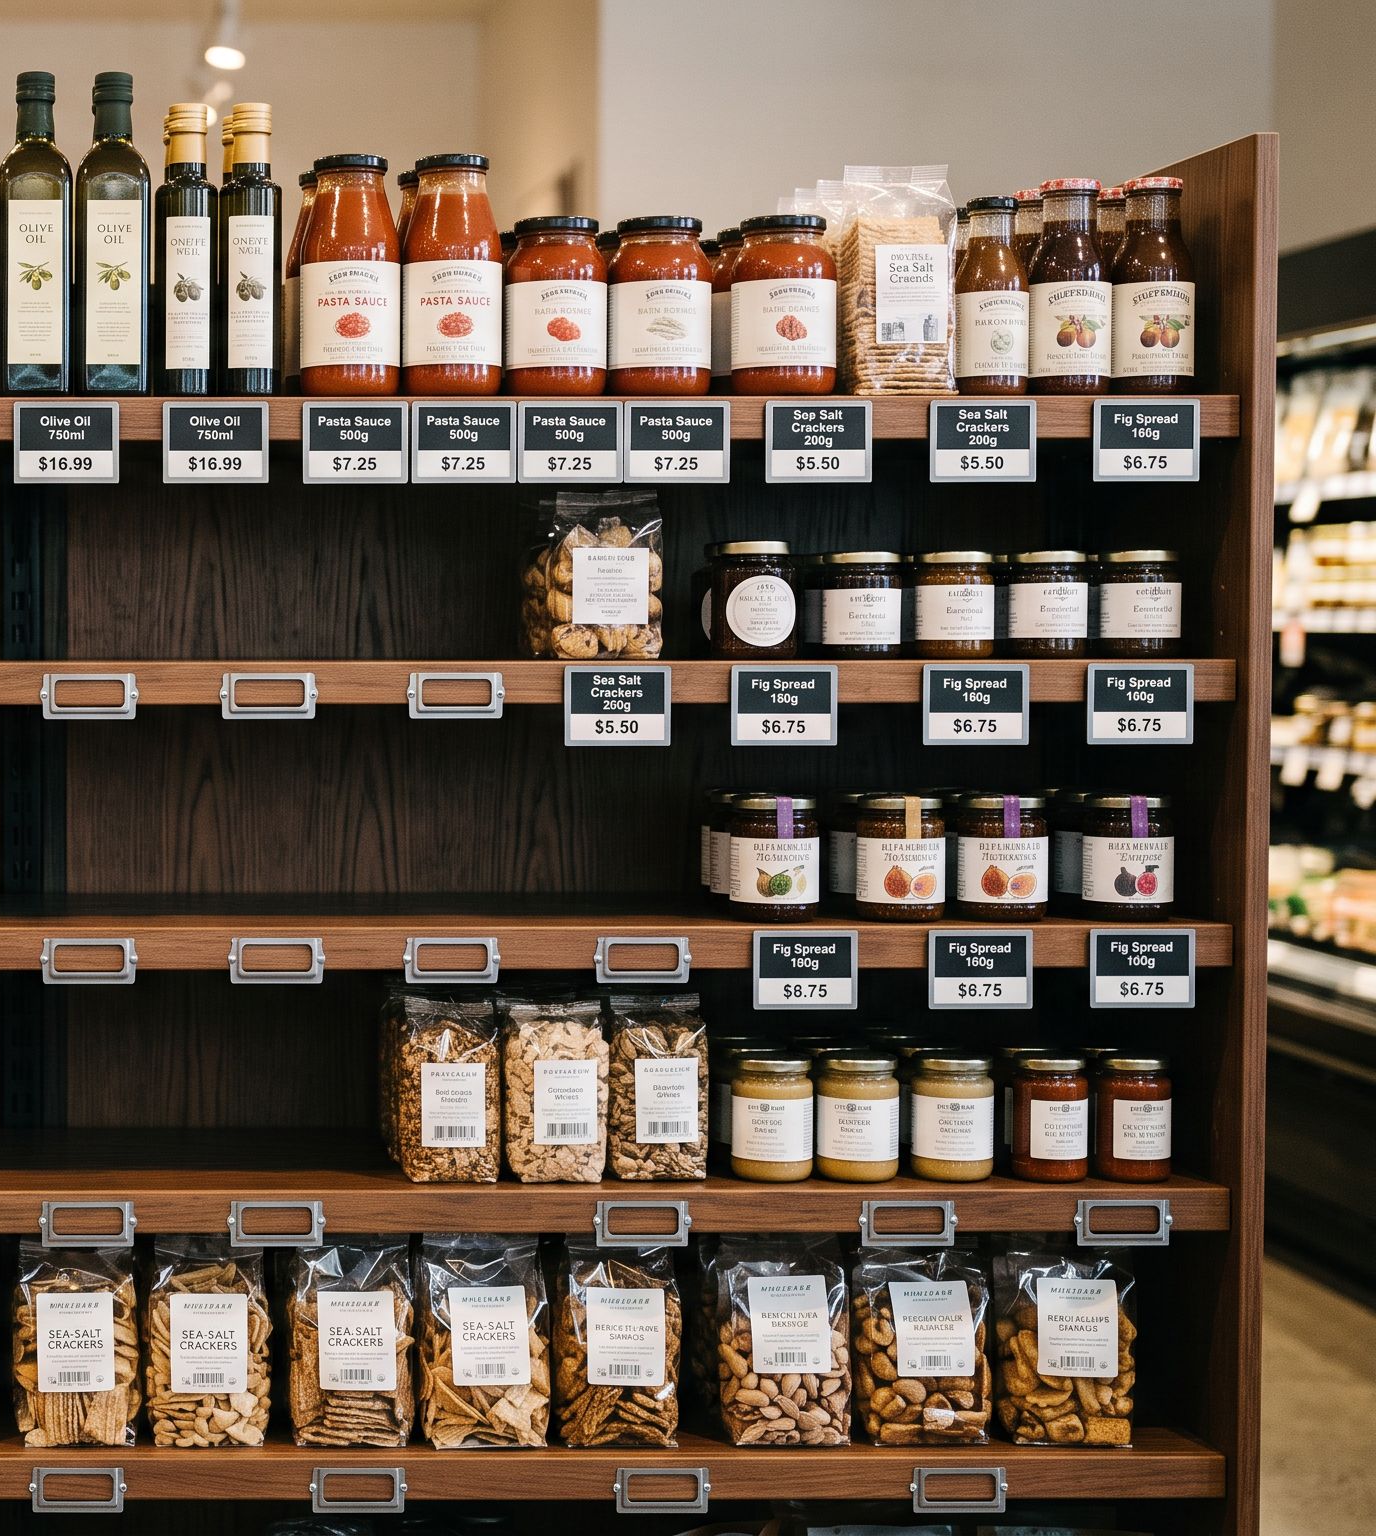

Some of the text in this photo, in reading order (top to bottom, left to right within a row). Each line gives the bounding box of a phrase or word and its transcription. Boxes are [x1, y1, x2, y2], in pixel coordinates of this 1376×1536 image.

[19, 224, 53, 232] OLIVE
[97, 224, 131, 232] OLIVE
[26, 235, 45, 243] OIL
[104, 235, 123, 244] OIL
[890, 263, 933, 272] Sea Salt
[318, 297, 389, 307] PASTA SAUCE
[421, 297, 492, 306] PASTA SAUCE
[959, 409, 1007, 419] Sea Salt
[40, 416, 90, 426] Olive Oil
[190, 416, 240, 426] Olive Oil
[318, 416, 391, 426] Pasta Sauce
[427, 416, 500, 426] Pasta Sauce
[533, 416, 606, 426] Pasta Sauce
[1114, 413, 1178, 426] Fig Spread
[956, 422, 1009, 432] Crackers
[49, 430, 84, 440] 750ml
[197, 430, 233, 440] 750ml
[340, 430, 368, 443] 500g
[450, 429, 478, 442] 500g
[555, 430, 584, 442] 500g
[969, 435, 997, 447] 200g
[38, 456, 93, 472] $16.99
[188, 456, 242, 472] $16.99
[332, 456, 377, 472] $7.25
[441, 456, 485, 472] $7.25
[547, 456, 592, 472] $7.25
[960, 455, 1004, 471] $5.50
[1123, 455, 1168, 471] $6.75
[752, 679, 815, 691] Fig Spread
[944, 678, 1007, 691] Fig Spread
[761, 719, 806, 735] $6.75
[953, 718, 997, 735] $6.75
[773, 944, 835, 957] Fig Spread
[949, 942, 1011, 956] Fig Spread
[783, 983, 828, 1000] $8.75
[958, 982, 1002, 999] $6.75
[463, 1321, 514, 1330] SEA-SALT
[49, 1329, 101, 1339] SEA-SALT
[182, 1330, 235, 1339] SEA-SALT
[463, 1332, 515, 1341] CRACKERS
[48, 1340, 103, 1349] CRACKERS
[180, 1341, 237, 1350] CRACKERS
